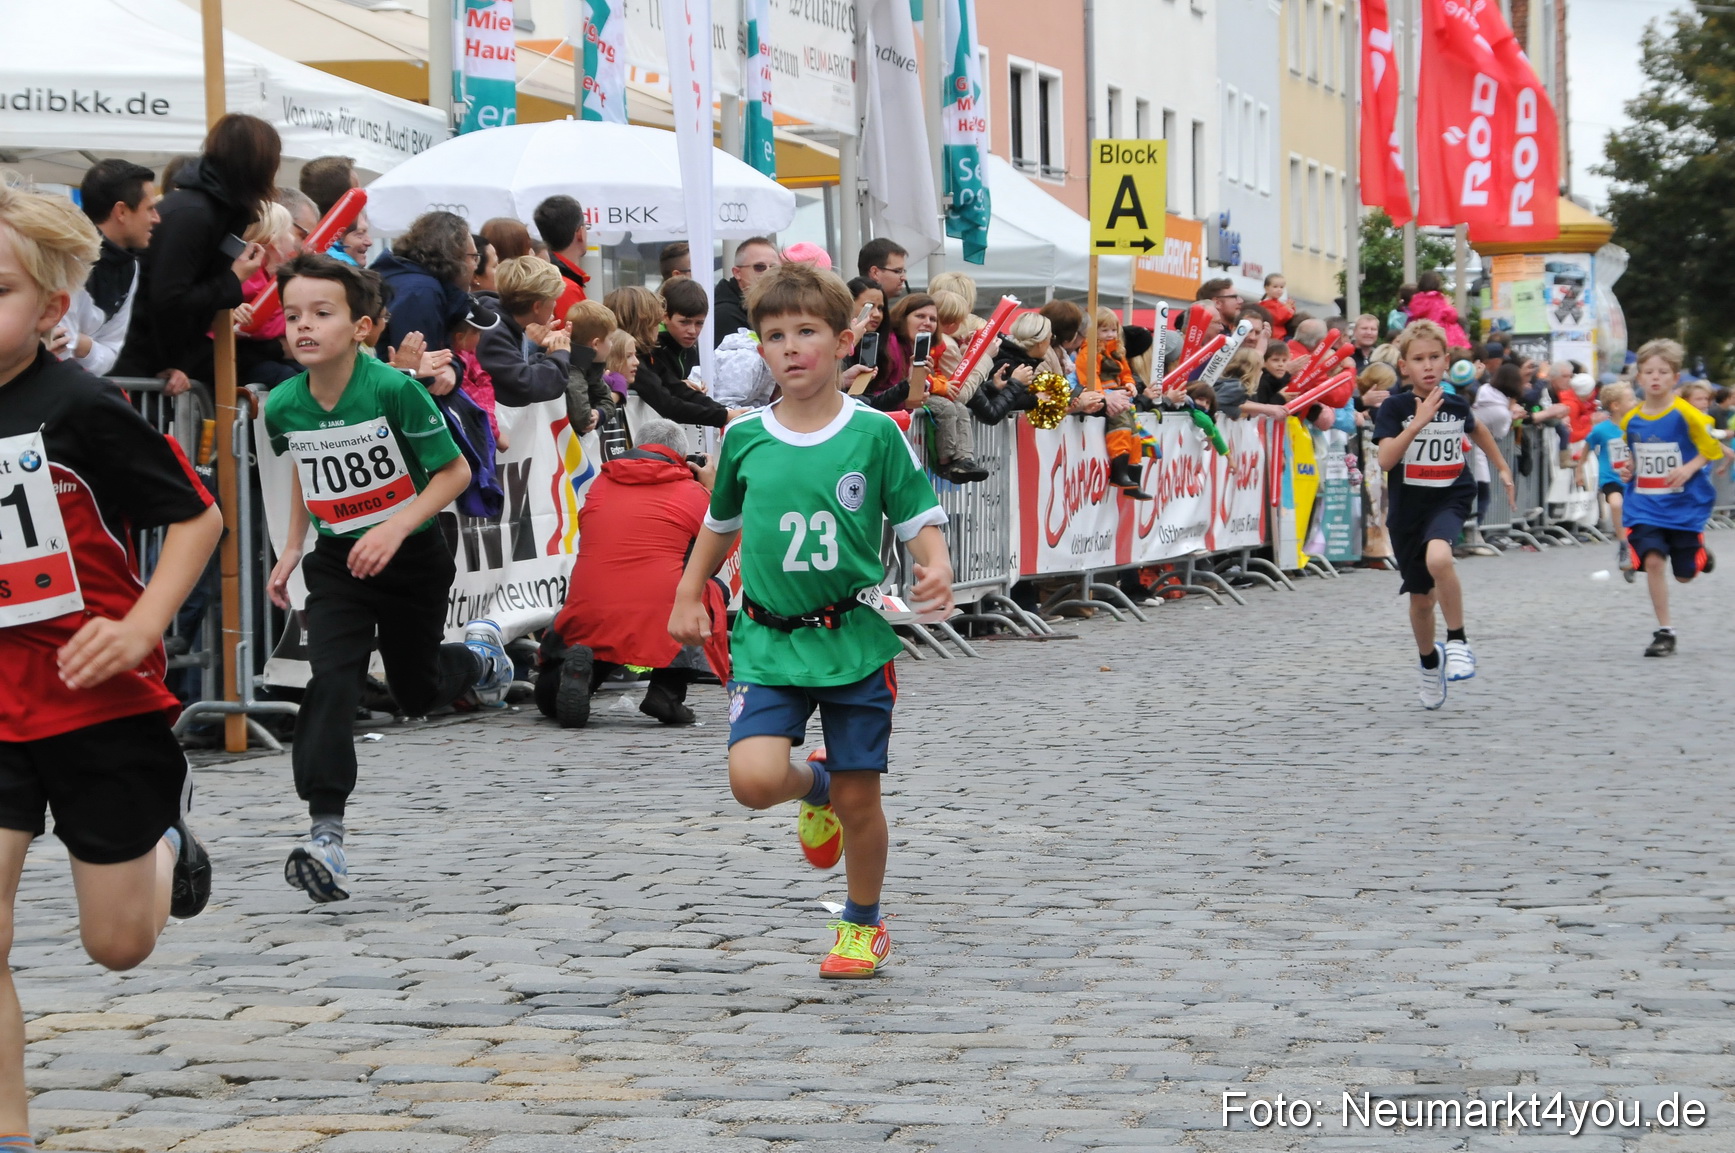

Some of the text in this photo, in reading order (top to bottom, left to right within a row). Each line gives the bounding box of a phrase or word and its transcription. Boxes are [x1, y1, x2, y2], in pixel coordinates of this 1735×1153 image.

[803, 45, 850, 80] NEUMARKT
[358, 118, 382, 144] uns:
[385, 120, 409, 153] Audi
[1460, 72, 1499, 206] ROD
[1100, 144, 1158, 164] Block
[1509, 87, 1538, 226] ROD
[608, 206, 659, 224] BKK
[1105, 174, 1149, 230] A
[969, 338, 984, 355] BKK
[327, 420, 345, 428] JAKO
[290, 433, 374, 452] PARTL Neumarkt
[301, 445, 396, 494] 7088
[0, 483, 39, 549] 1
[333, 497, 383, 519] Marco
[779, 510, 839, 572] 23
